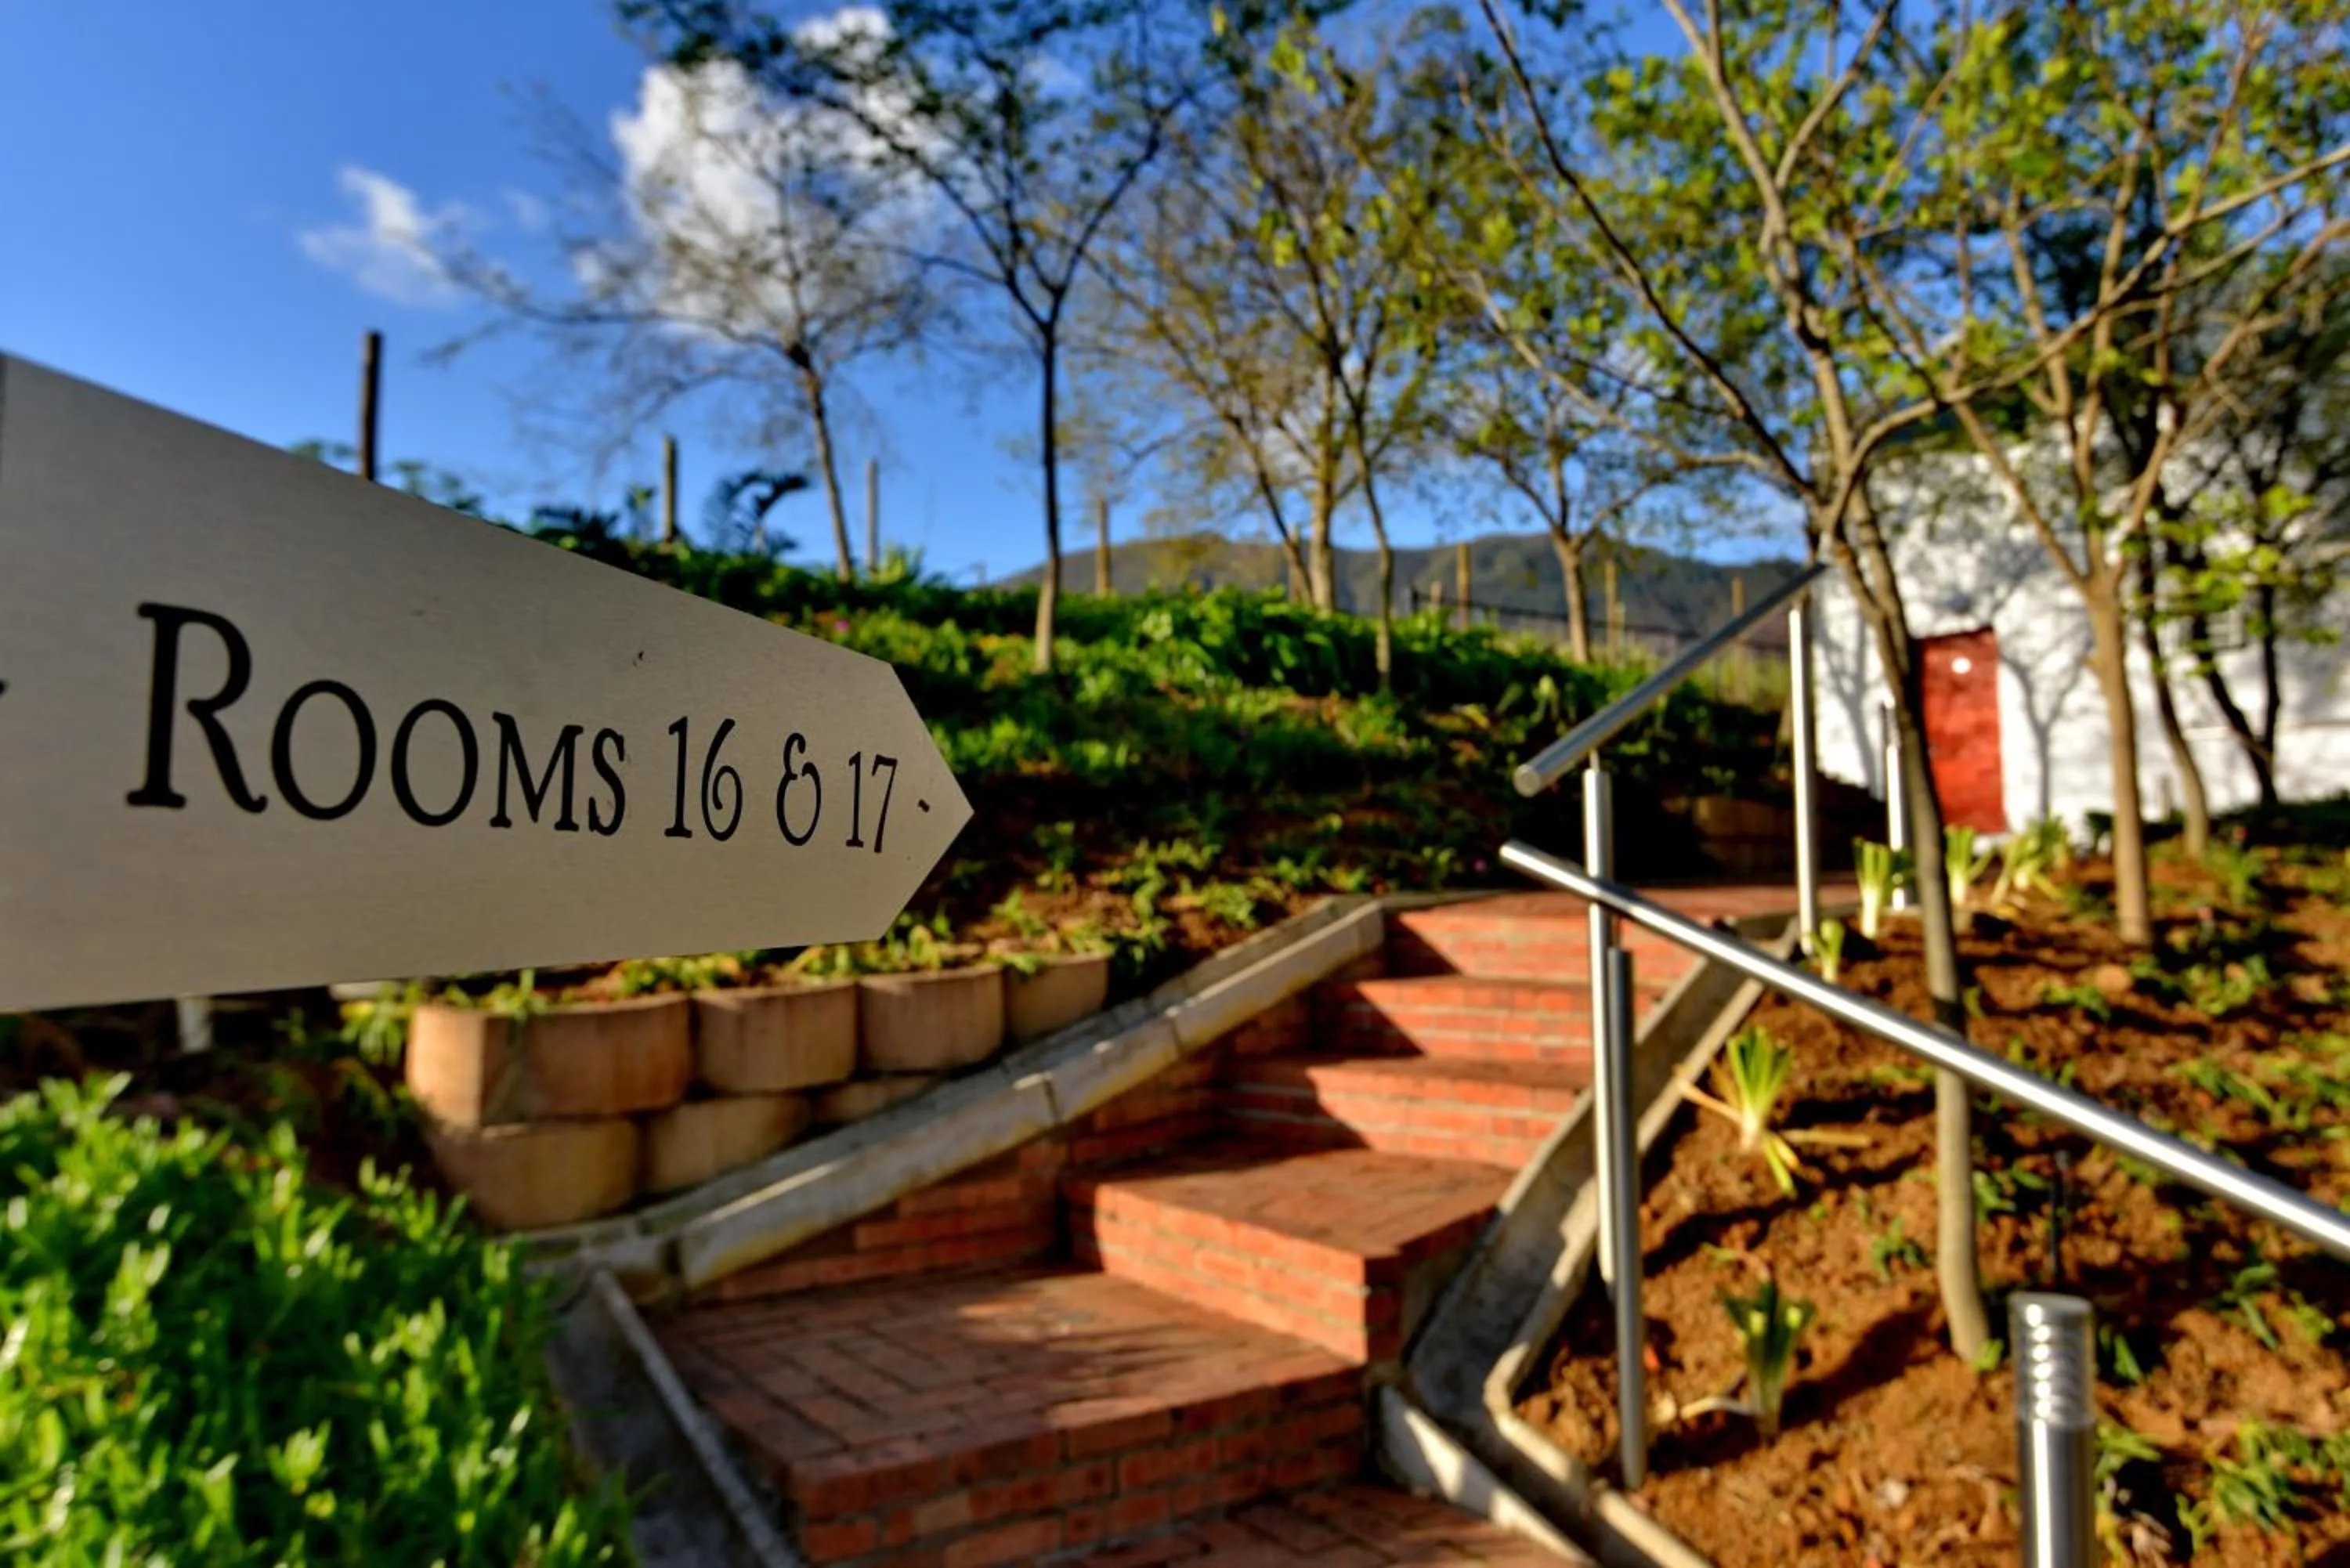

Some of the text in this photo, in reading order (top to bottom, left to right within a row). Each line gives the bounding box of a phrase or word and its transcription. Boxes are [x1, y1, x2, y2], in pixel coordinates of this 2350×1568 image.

[125, 601, 898, 854] ROOMS 16 & 17
